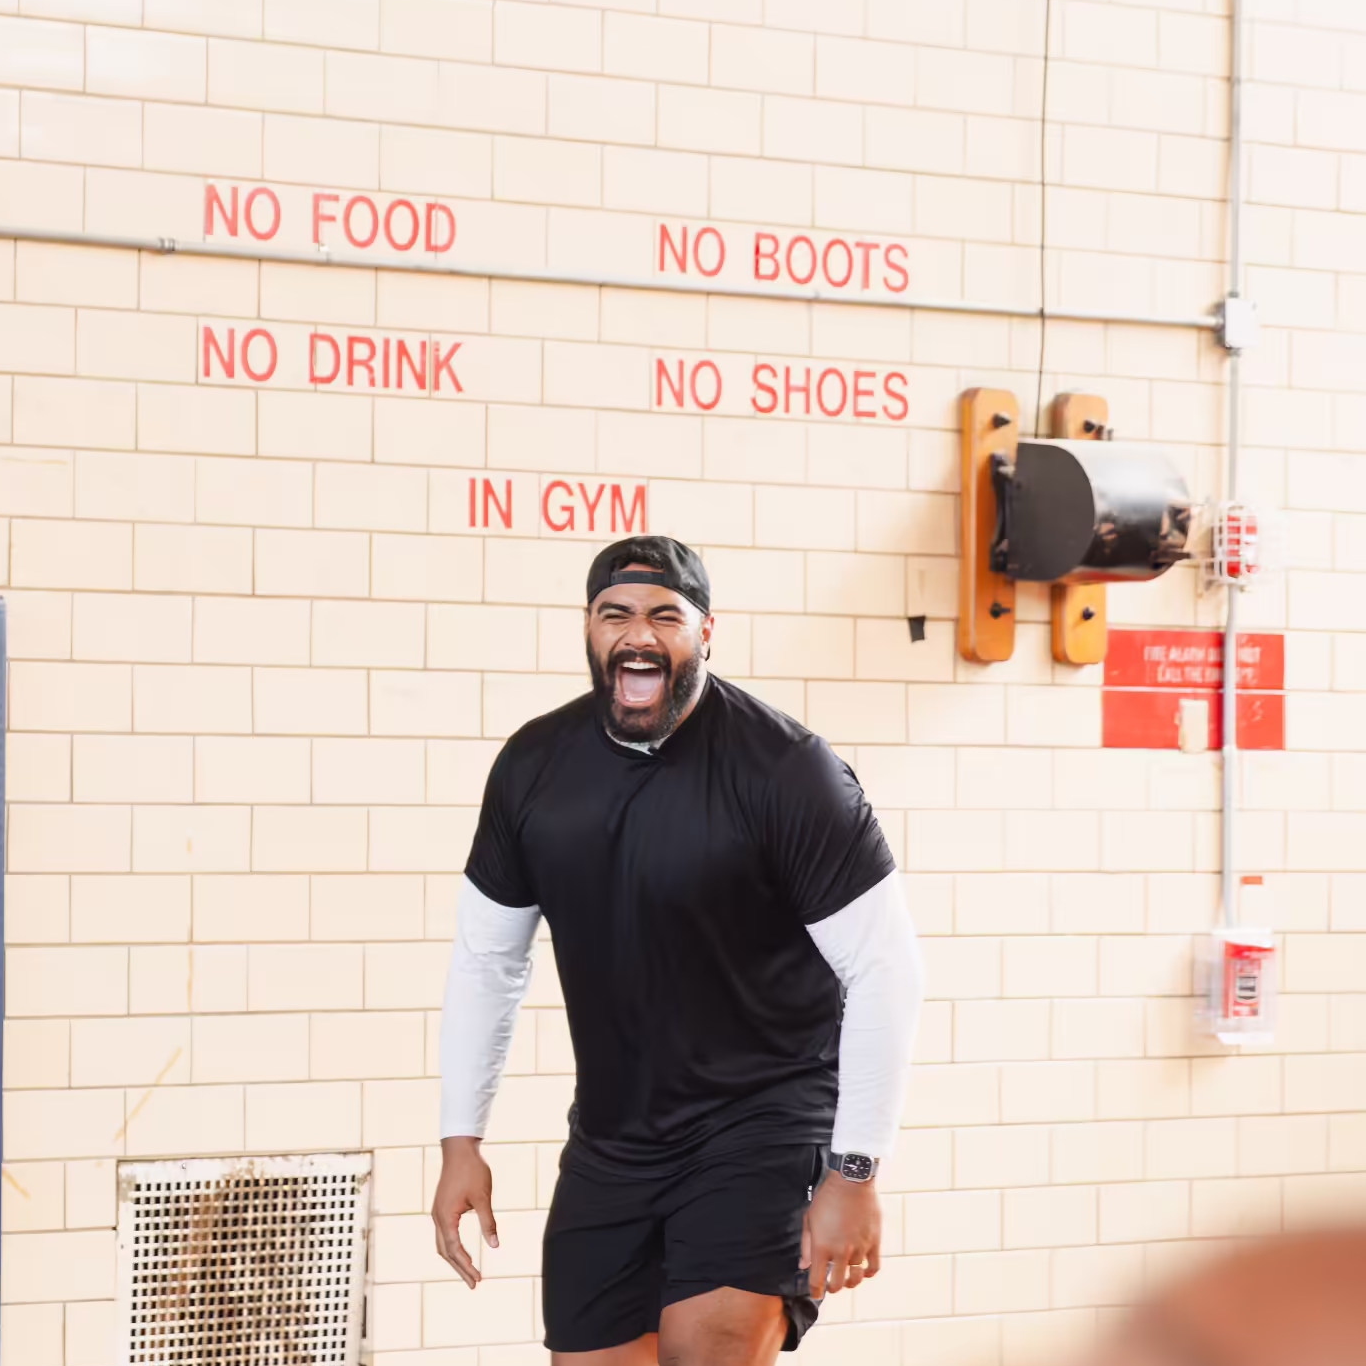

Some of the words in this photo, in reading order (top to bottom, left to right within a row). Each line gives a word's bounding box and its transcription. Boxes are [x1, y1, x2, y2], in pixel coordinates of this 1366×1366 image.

[203, 183, 282, 242] NO
[311, 192, 457, 253] FOOD
[658, 222, 725, 277] NO
[753, 231, 909, 293] BOOTS
[202, 325, 279, 383] NO
[307, 332, 464, 394] DRINK
[655, 357, 723, 411] NO
[750, 363, 909, 422] SHOES
[468, 477, 513, 530] IN
[542, 479, 646, 534] GYM
